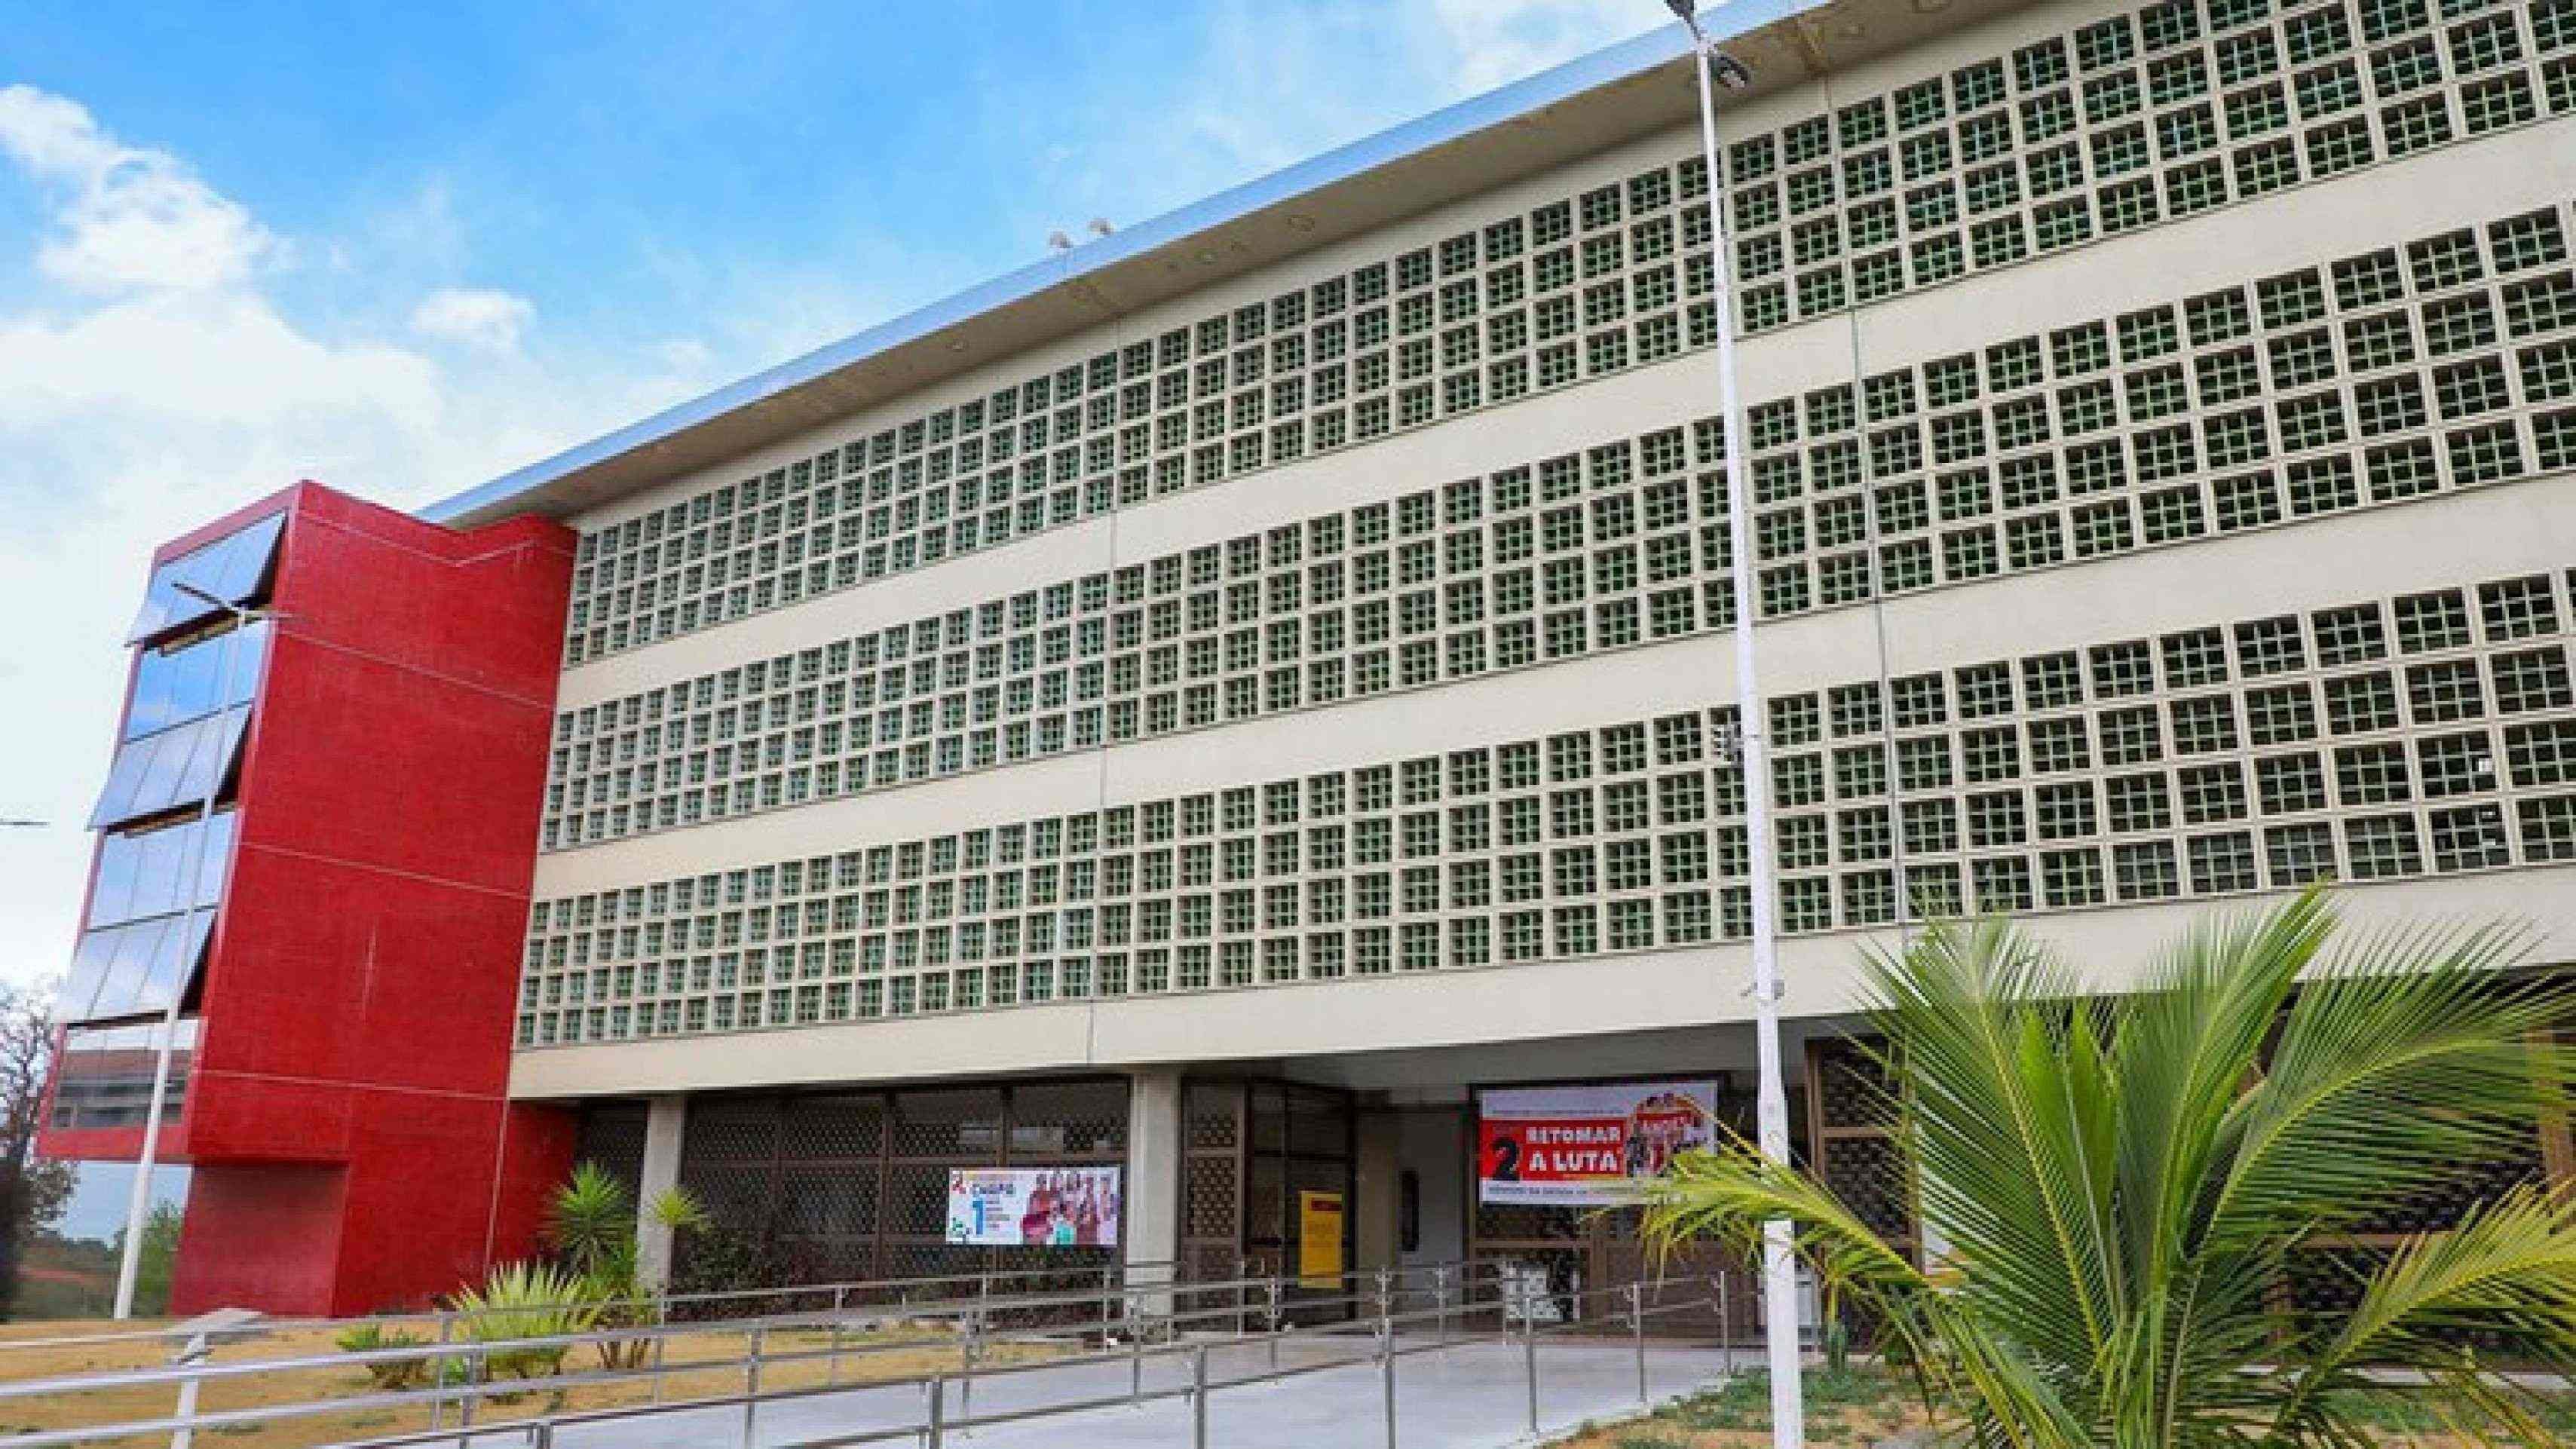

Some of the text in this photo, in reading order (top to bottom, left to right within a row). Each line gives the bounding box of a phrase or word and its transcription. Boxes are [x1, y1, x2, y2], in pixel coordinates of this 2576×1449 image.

[1526, 1126, 1620, 1144] RETOMAR
[1493, 1137, 1518, 1181] 2
[1529, 1150, 1618, 1171] A LUTA
[972, 1199, 984, 1235] 1
